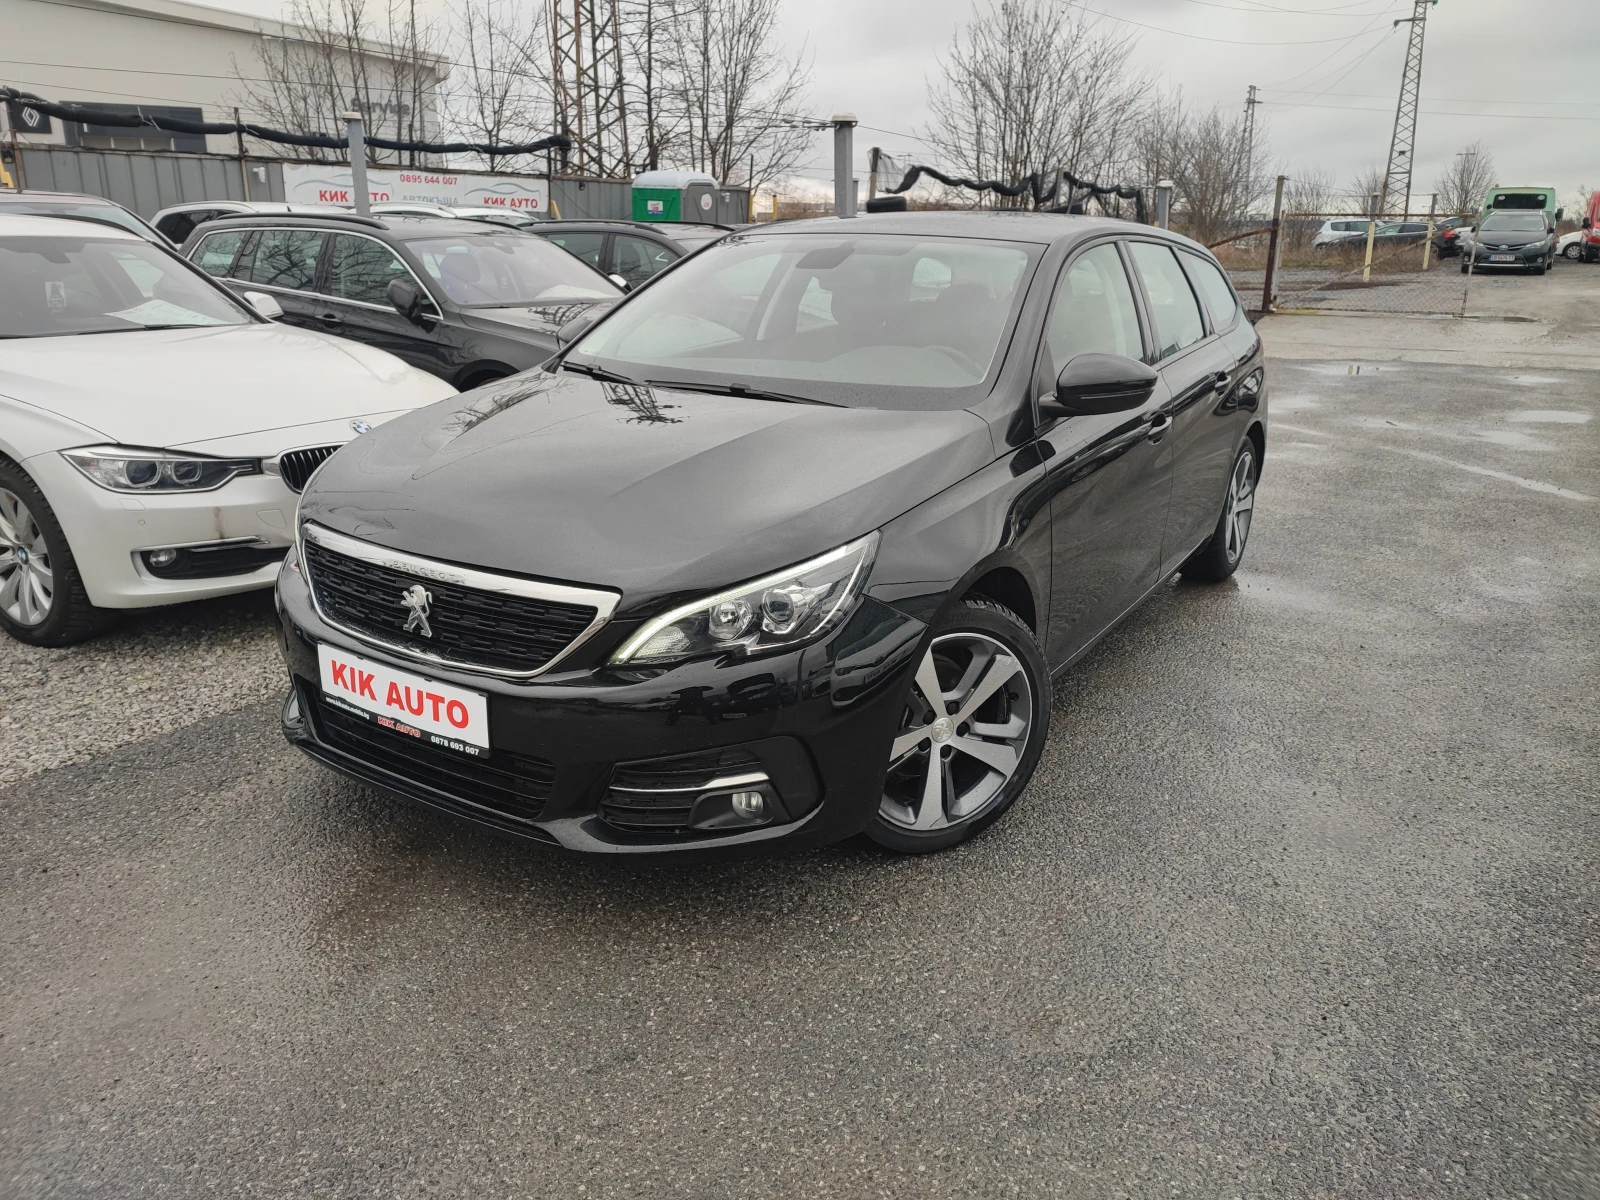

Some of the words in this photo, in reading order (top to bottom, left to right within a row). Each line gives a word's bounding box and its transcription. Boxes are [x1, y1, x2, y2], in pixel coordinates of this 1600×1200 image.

[400, 174, 422, 184] 0895
[424, 175, 440, 185] 644
[443, 176, 458, 186] 007
[319, 189, 348, 203] КИК
[483, 196, 506, 207] КИК
[510, 197, 538, 209] АУТО
[393, 560, 456, 581] PEUGEOT
[331, 659, 378, 702] KIK
[386, 681, 469, 729] AUTO
[377, 716, 395, 730] KIK
[396, 723, 421, 738] AUTO
[431, 735, 449, 747] 0878
[450, 741, 464, 752] 693
[465, 746, 480, 756] 007
